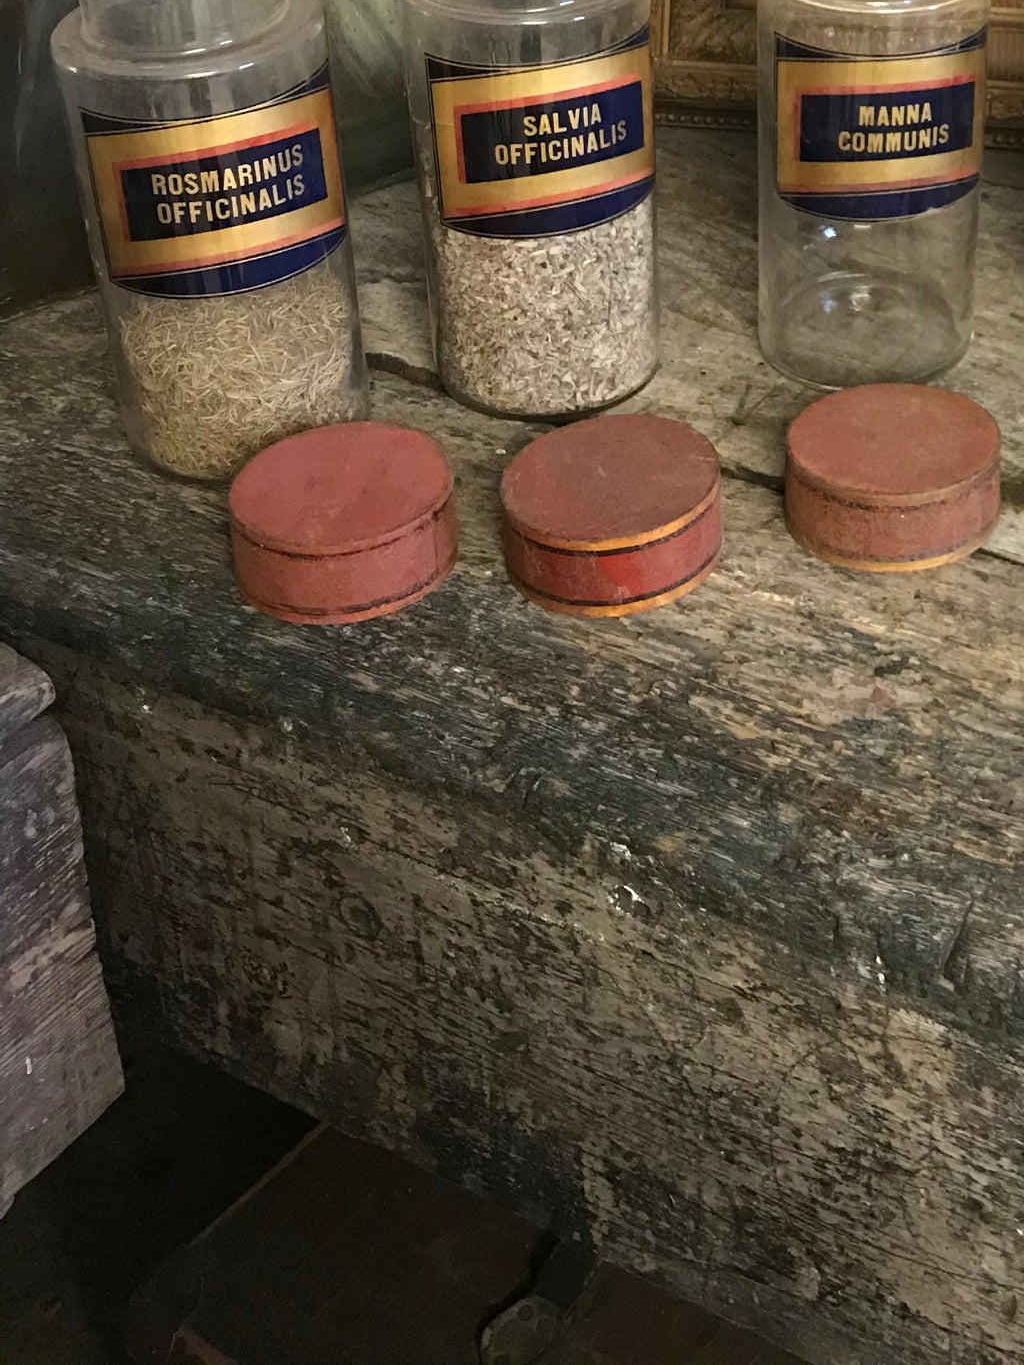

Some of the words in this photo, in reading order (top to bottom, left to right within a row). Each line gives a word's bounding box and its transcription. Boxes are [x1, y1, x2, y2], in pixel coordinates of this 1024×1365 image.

[523, 103, 602, 136] SALVIA
[858, 102, 932, 126] MANNA
[494, 120, 627, 165] OFFICINALIS
[837, 124, 949, 153] COMMUNIS
[151, 144, 304, 196] ROSMARINUS
[156, 174, 305, 224] OFFICINALIS
